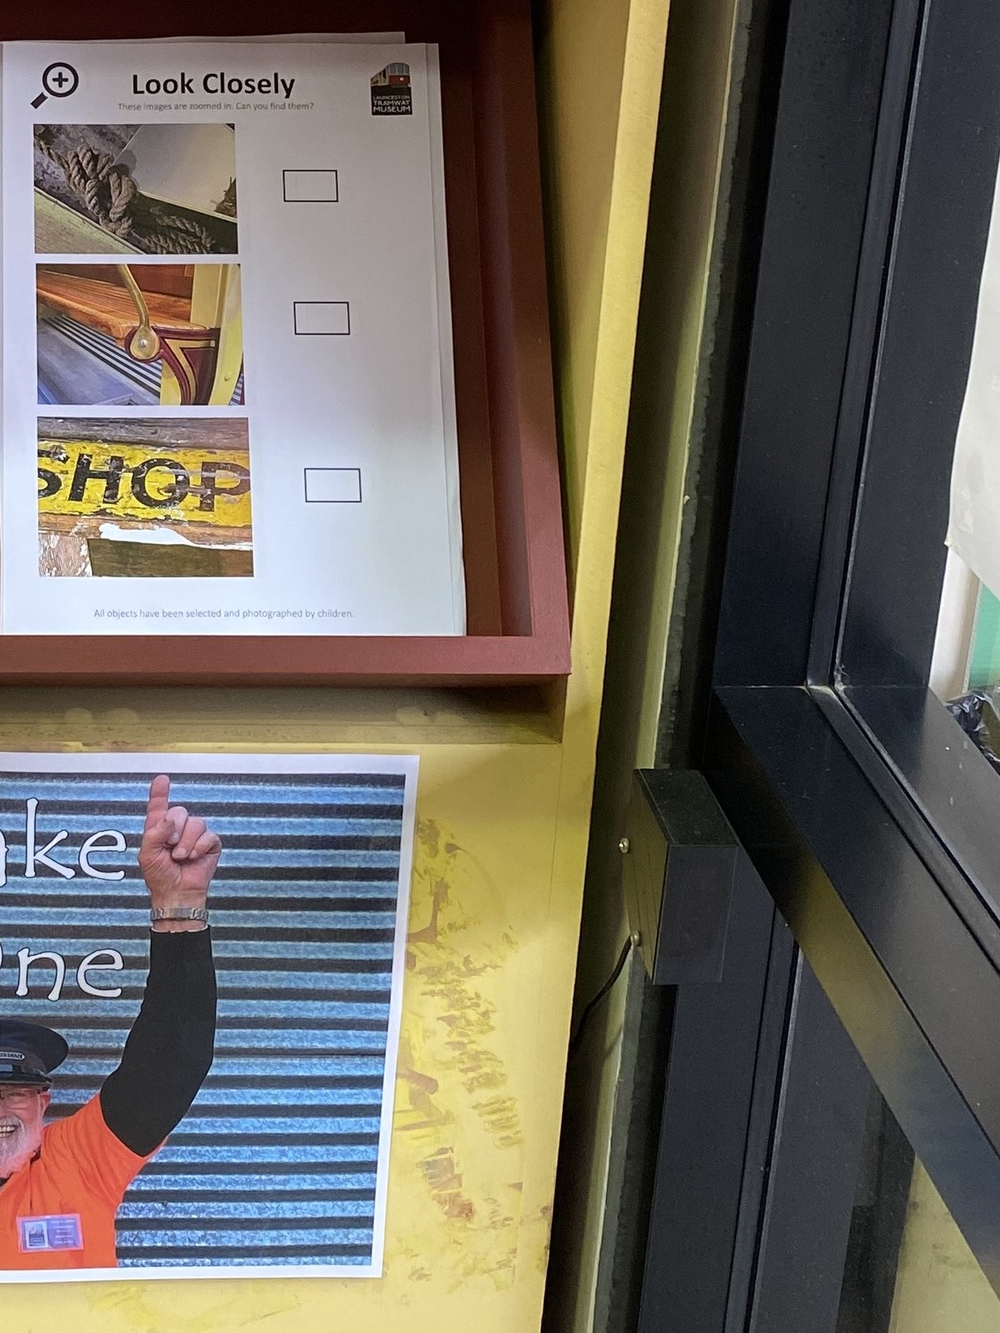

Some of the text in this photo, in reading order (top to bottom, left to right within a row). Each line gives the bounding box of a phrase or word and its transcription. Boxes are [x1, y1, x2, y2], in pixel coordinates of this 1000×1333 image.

[132, 72, 296, 99] Look Closely
[118, 103, 141, 111] These
[144, 103, 172, 112] images
[189, 102, 222, 110] zoomed
[236, 102, 250, 110] Can
[269, 102, 286, 110] find
[287, 102, 314, 110] them?
[38, 449, 251, 512] SHOP
[94, 609, 355, 620] All objects have been selected and photographed by children.
